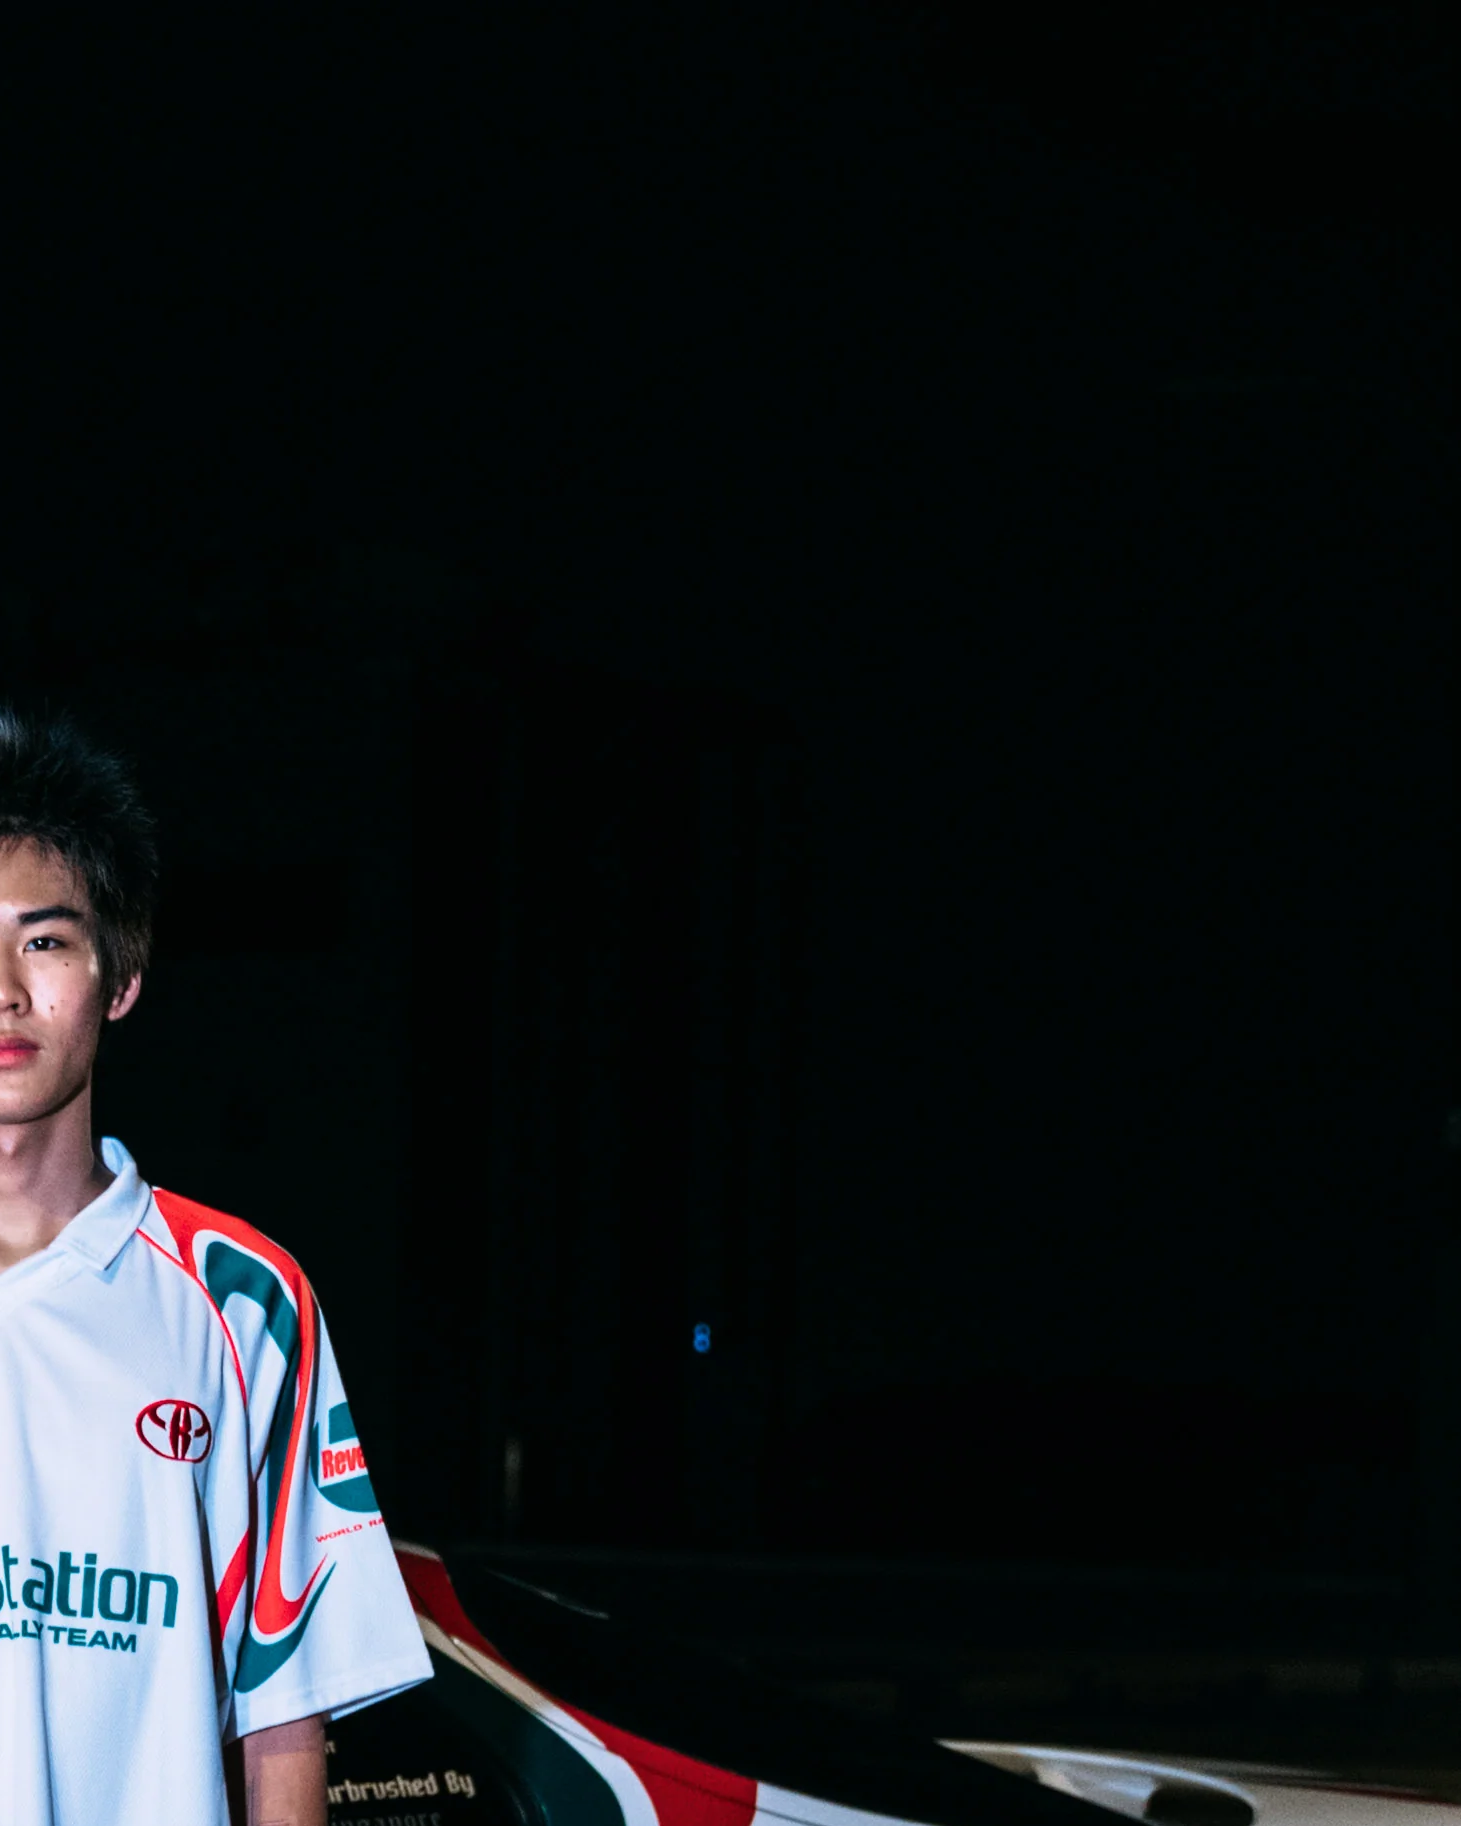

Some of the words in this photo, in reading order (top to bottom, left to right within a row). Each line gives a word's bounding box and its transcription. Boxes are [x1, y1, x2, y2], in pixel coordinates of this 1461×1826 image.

[315, 1524, 363, 1543] WORLD
[47, 1625, 137, 1653] TEAM
[443, 1768, 478, 1800] By
